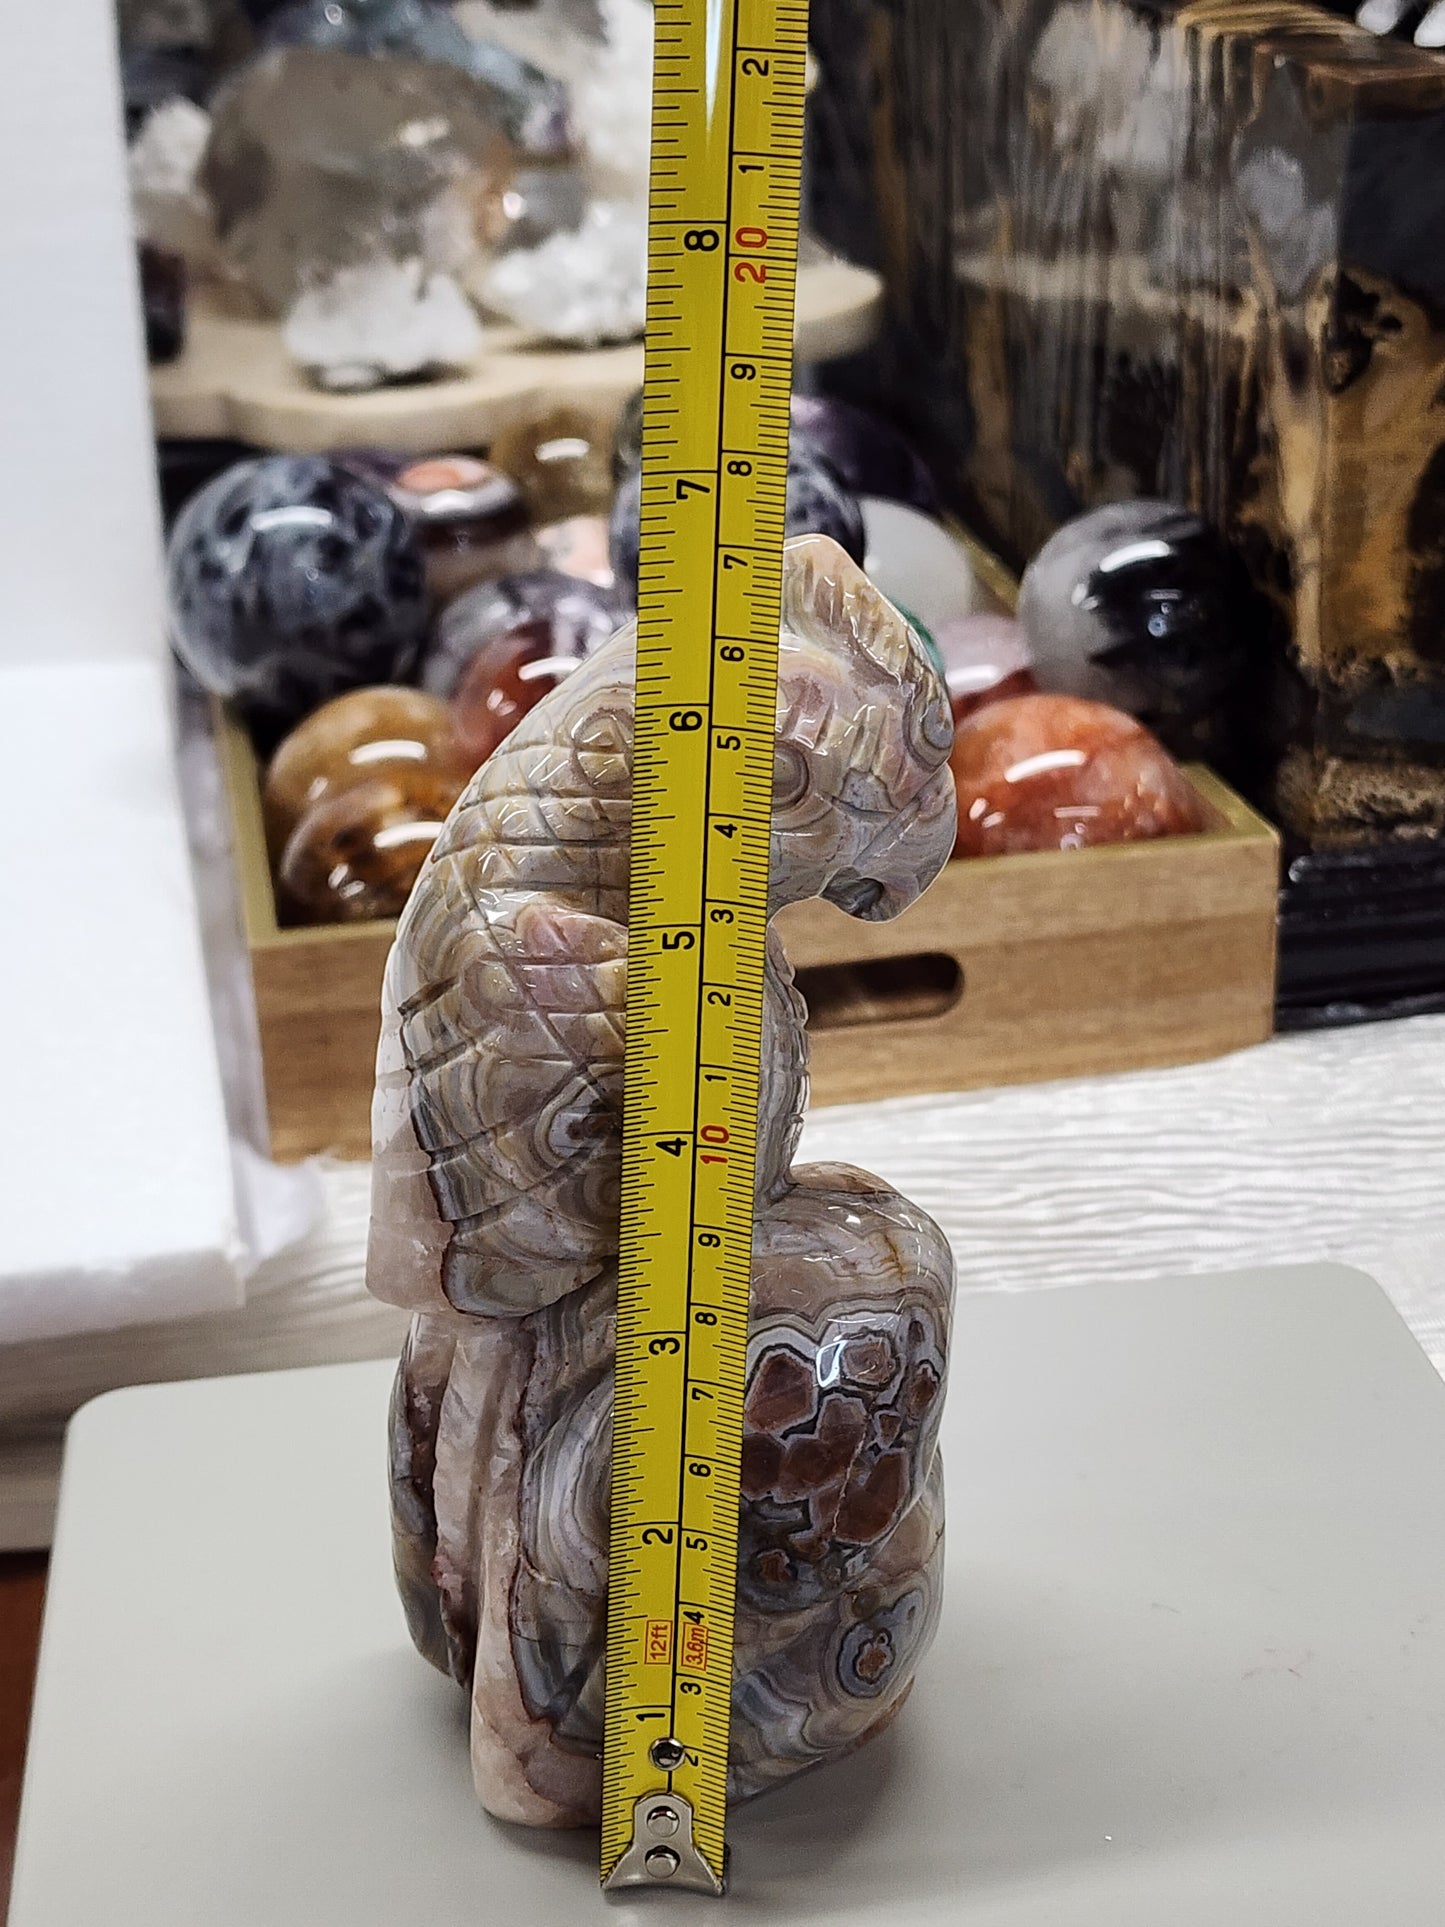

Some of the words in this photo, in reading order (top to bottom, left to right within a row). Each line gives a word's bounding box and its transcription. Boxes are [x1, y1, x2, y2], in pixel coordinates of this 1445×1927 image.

[742, 58, 769, 76] 2
[738, 164, 765, 173] 1
[684, 229, 720, 251] 8
[734, 227, 768, 283] 20
[730, 363, 756, 381] 9
[727, 460, 752, 476] 8
[676, 479, 711, 500] 7
[723, 554, 749, 569] 7
[720, 645, 745, 662] 6
[669, 710, 703, 731] 6
[716, 734, 741, 751] 5
[713, 823, 738, 839] 4
[710, 908, 734, 924] 3
[662, 931, 695, 951] 5
[707, 991, 731, 1007] 2
[704, 1074, 728, 1082] 1
[656, 1137, 688, 1157] 4
[700, 1125, 730, 1164] 10
[697, 1233, 721, 1248] 9
[694, 1311, 718, 1326] 8
[648, 1337, 681, 1356] 3
[691, 1387, 714, 1401] 7
[688, 1462, 711, 1477] 6
[642, 1528, 673, 1545] 2
[686, 1536, 708, 1551] 5
[683, 1610, 705, 1625] 4
[650, 1624, 668, 1660] 12ft
[680, 1681, 702, 1695] 3
[636, 1712, 665, 1722] 1
